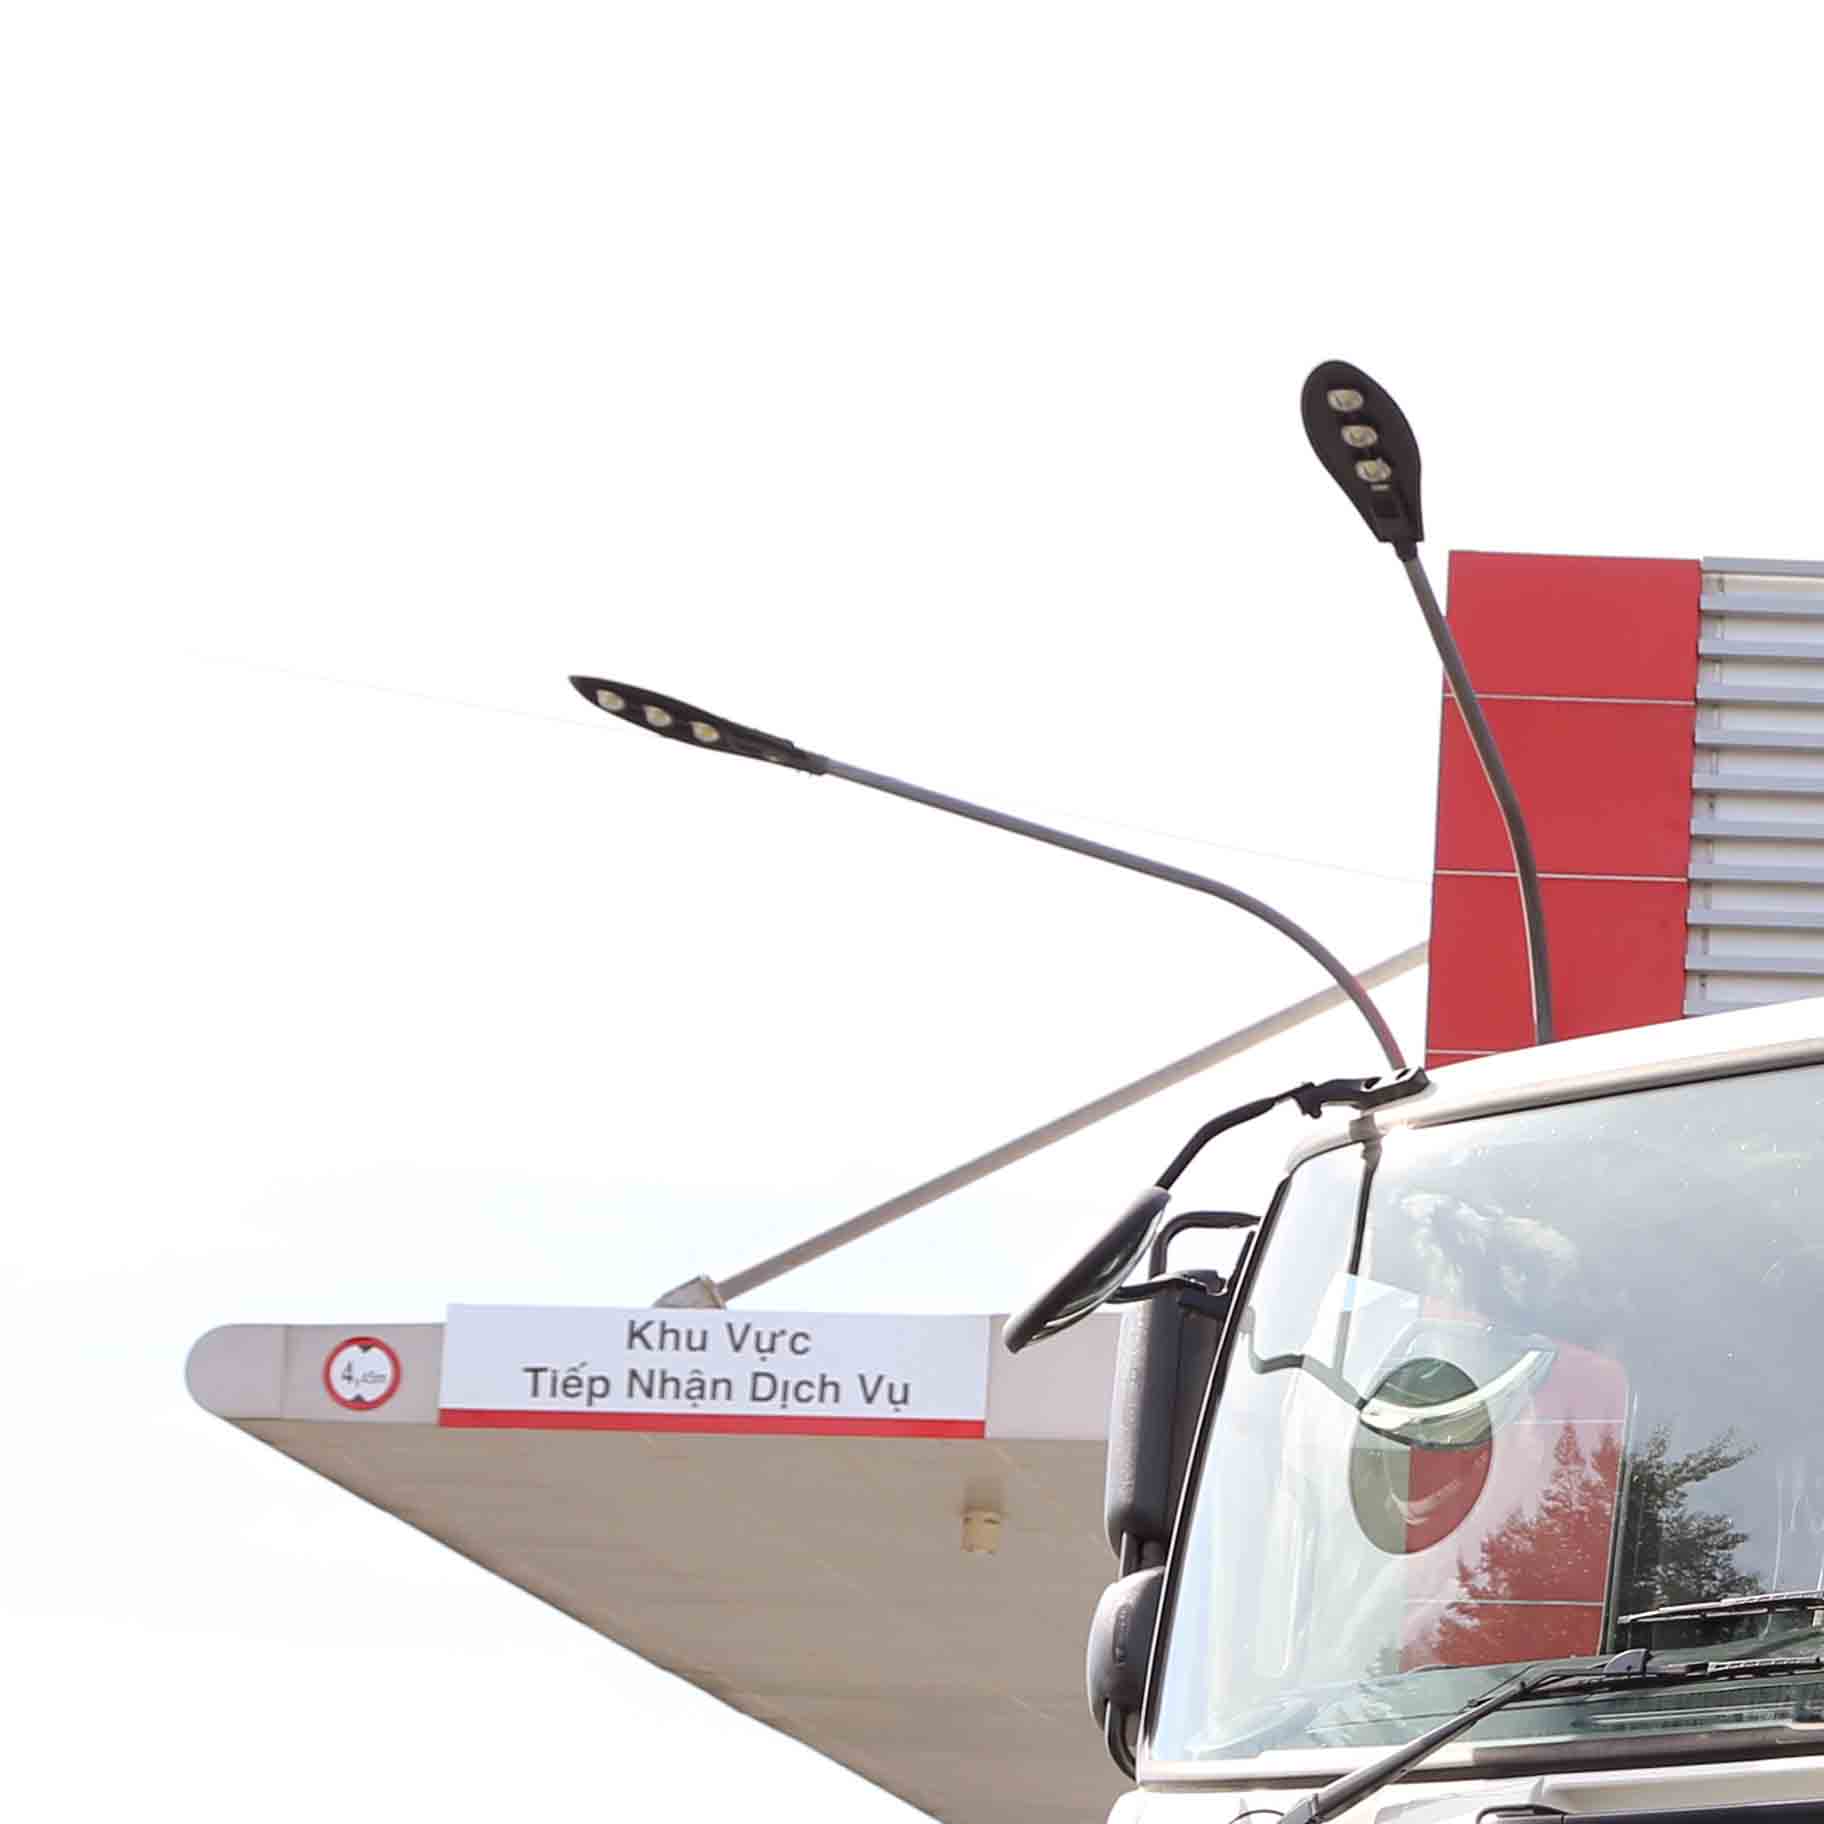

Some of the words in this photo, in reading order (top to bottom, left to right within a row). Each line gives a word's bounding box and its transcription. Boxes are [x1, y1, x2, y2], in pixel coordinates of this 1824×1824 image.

[626, 1319, 709, 1352] Khu
[725, 1321, 812, 1362] Vực
[523, 1362, 611, 1406] Tiếp
[626, 1368, 733, 1408] Nhận
[749, 1371, 841, 1410] Dịch
[858, 1373, 911, 1413] Vụ
